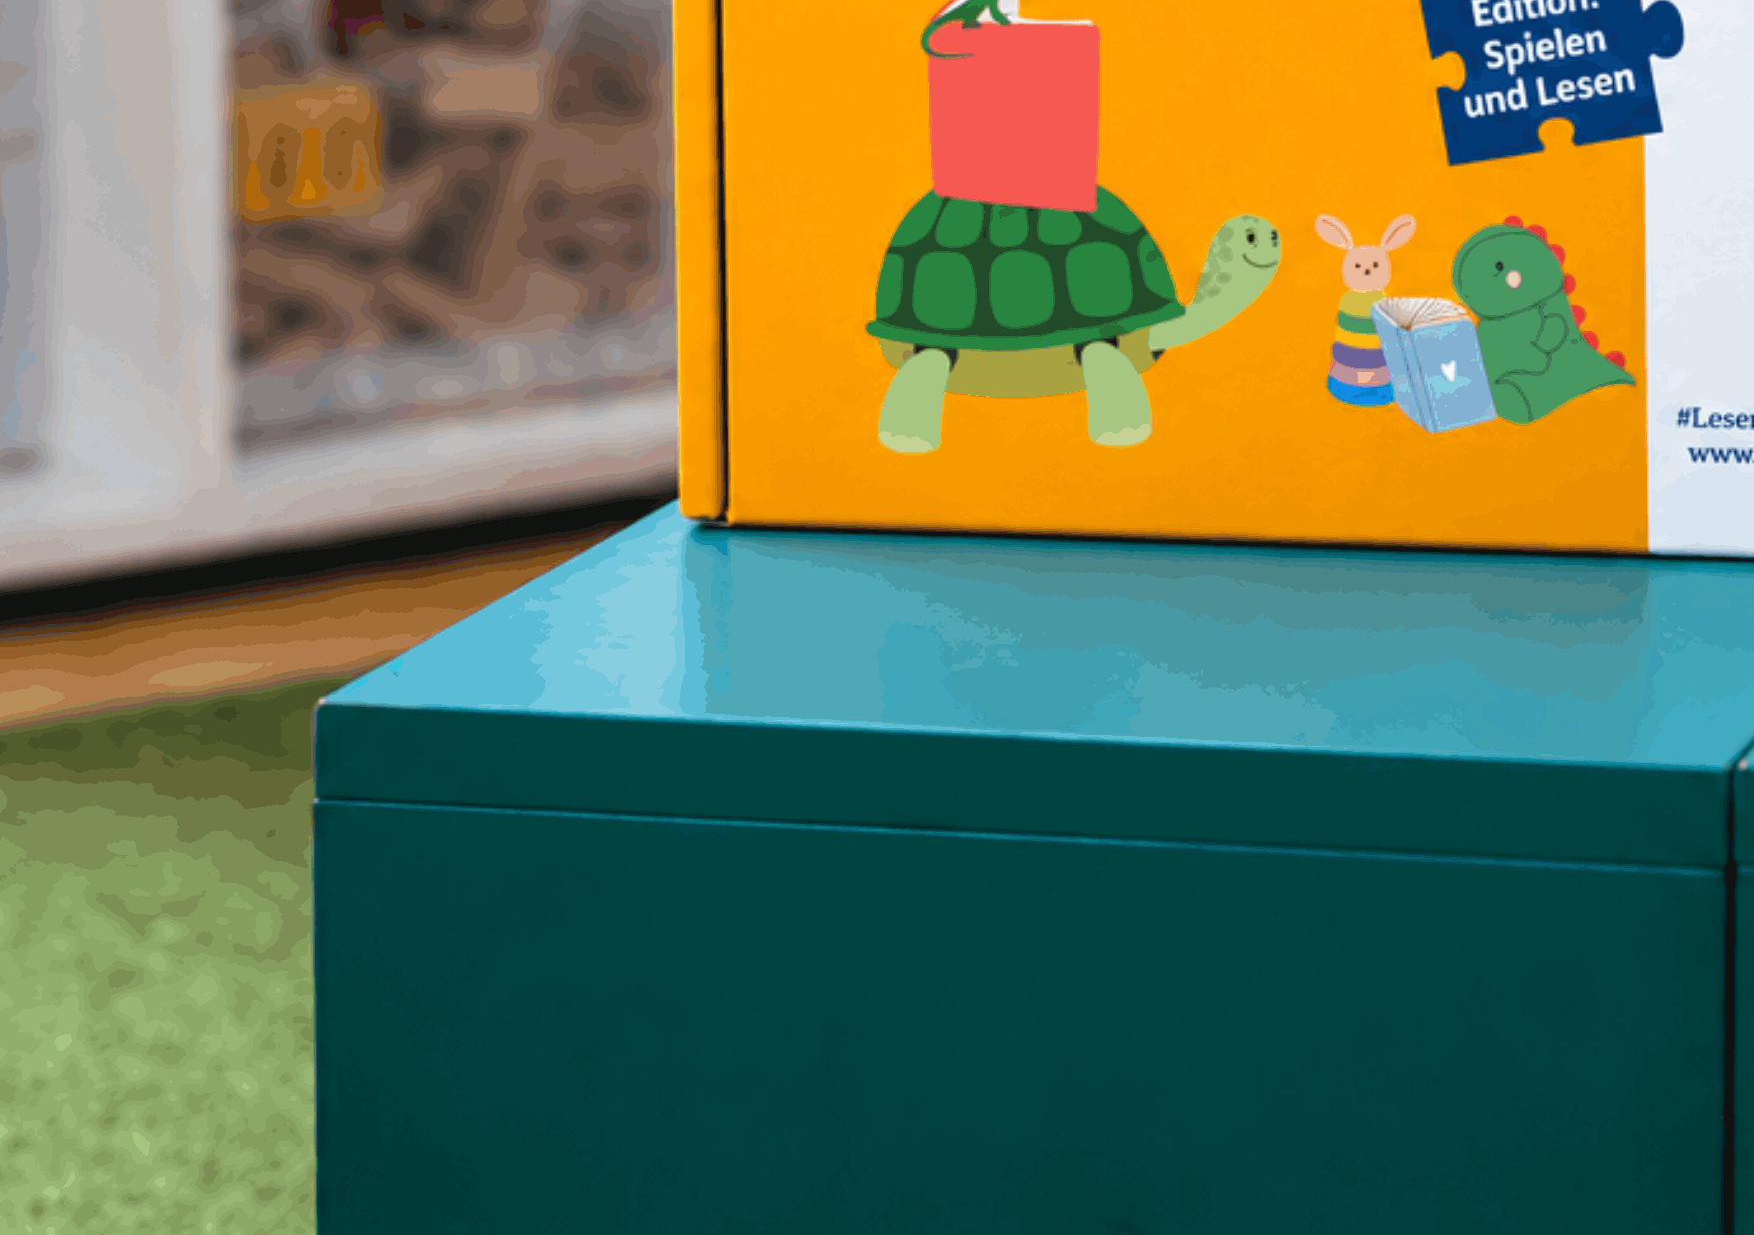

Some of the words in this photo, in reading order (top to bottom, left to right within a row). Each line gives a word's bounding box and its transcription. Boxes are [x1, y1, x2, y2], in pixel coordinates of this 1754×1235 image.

[1484, 27, 1607, 76] Spielen
[1464, 77, 1528, 118] und
[1536, 68, 1636, 106] Lesen
